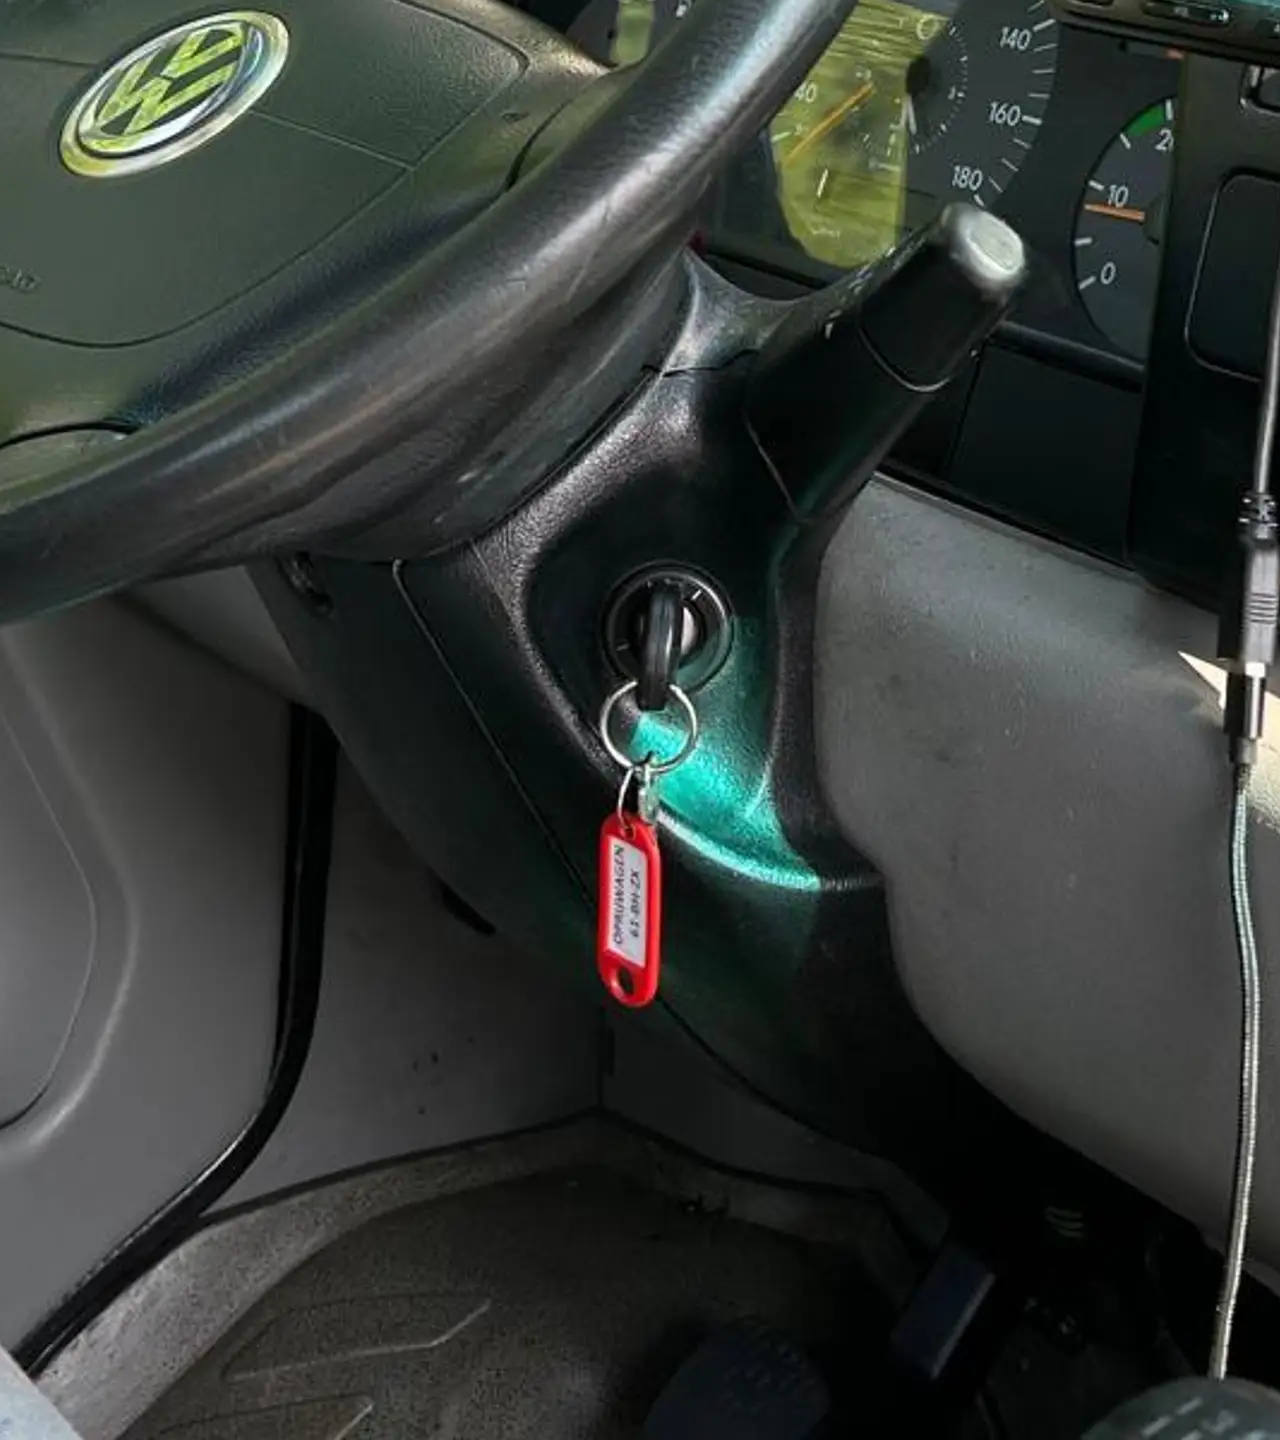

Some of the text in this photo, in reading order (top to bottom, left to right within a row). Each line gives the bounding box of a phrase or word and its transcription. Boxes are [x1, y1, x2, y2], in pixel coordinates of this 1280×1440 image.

[999, 25, 1032, 51] 140
[988, 100, 1022, 127] 160
[951, 164, 983, 191] 180
[1106, 183, 1130, 209] 10
[1099, 260, 1118, 286] 0
